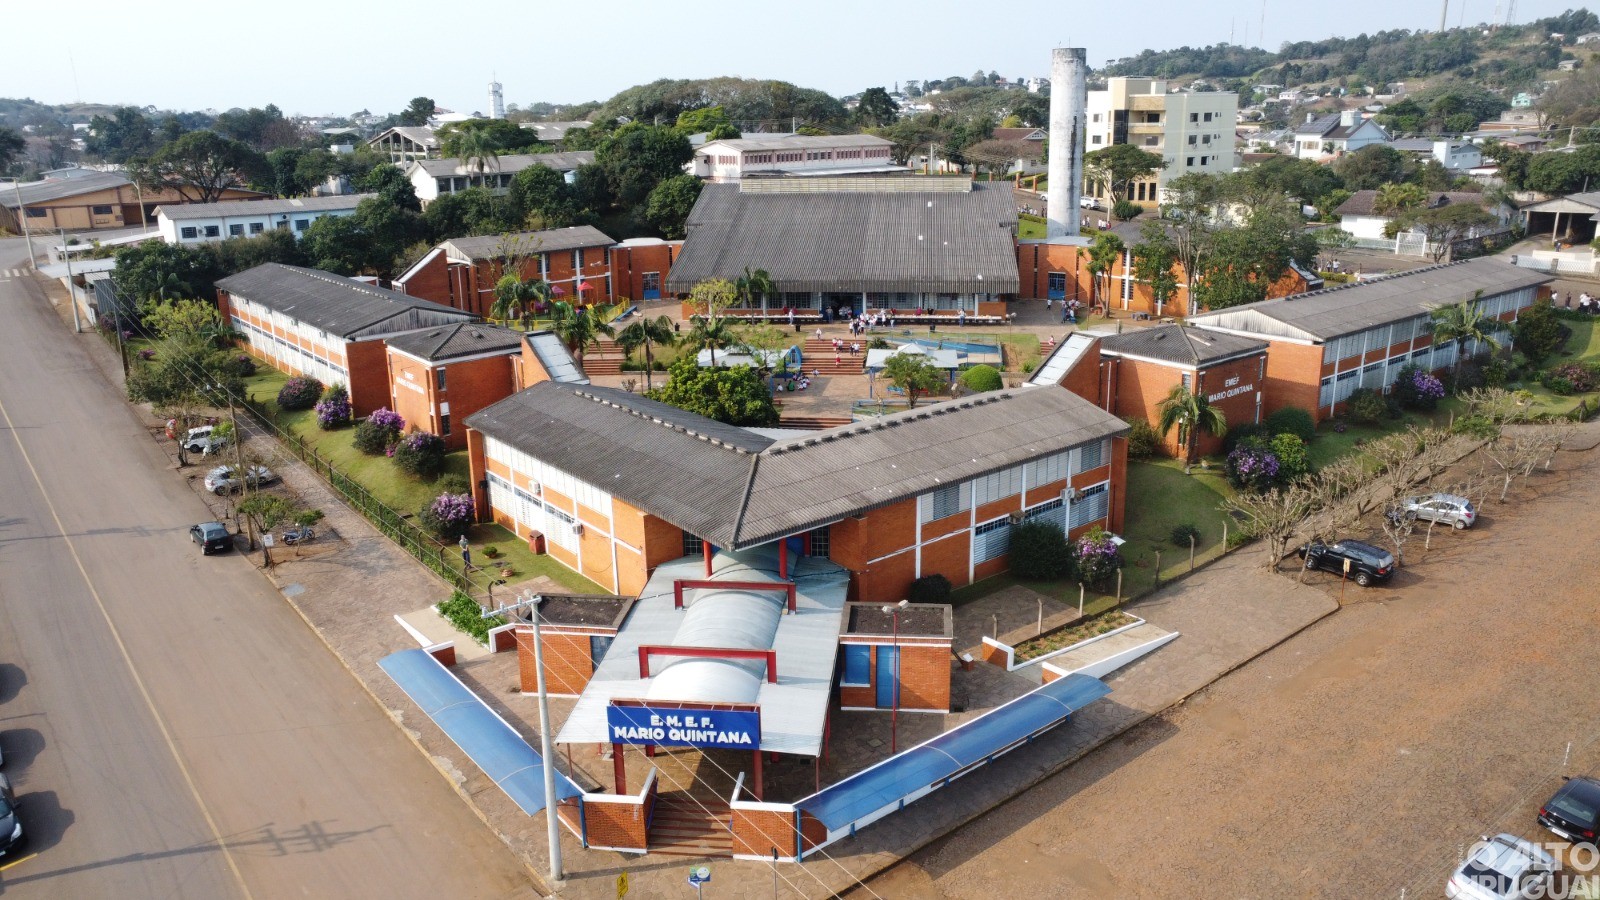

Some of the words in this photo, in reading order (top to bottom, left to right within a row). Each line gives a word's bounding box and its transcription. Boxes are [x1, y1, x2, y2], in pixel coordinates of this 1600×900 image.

[1208, 391, 1226, 402] MARIO
[1227, 384, 1253, 397] QUINTANA
[651, 715, 663, 726] E.
[666, 715, 682, 727] M.
[685, 716, 698, 728] E.
[701, 717, 714, 729] F.
[614, 726, 665, 740] MARIO
[668, 728, 752, 744] QUINTANA
